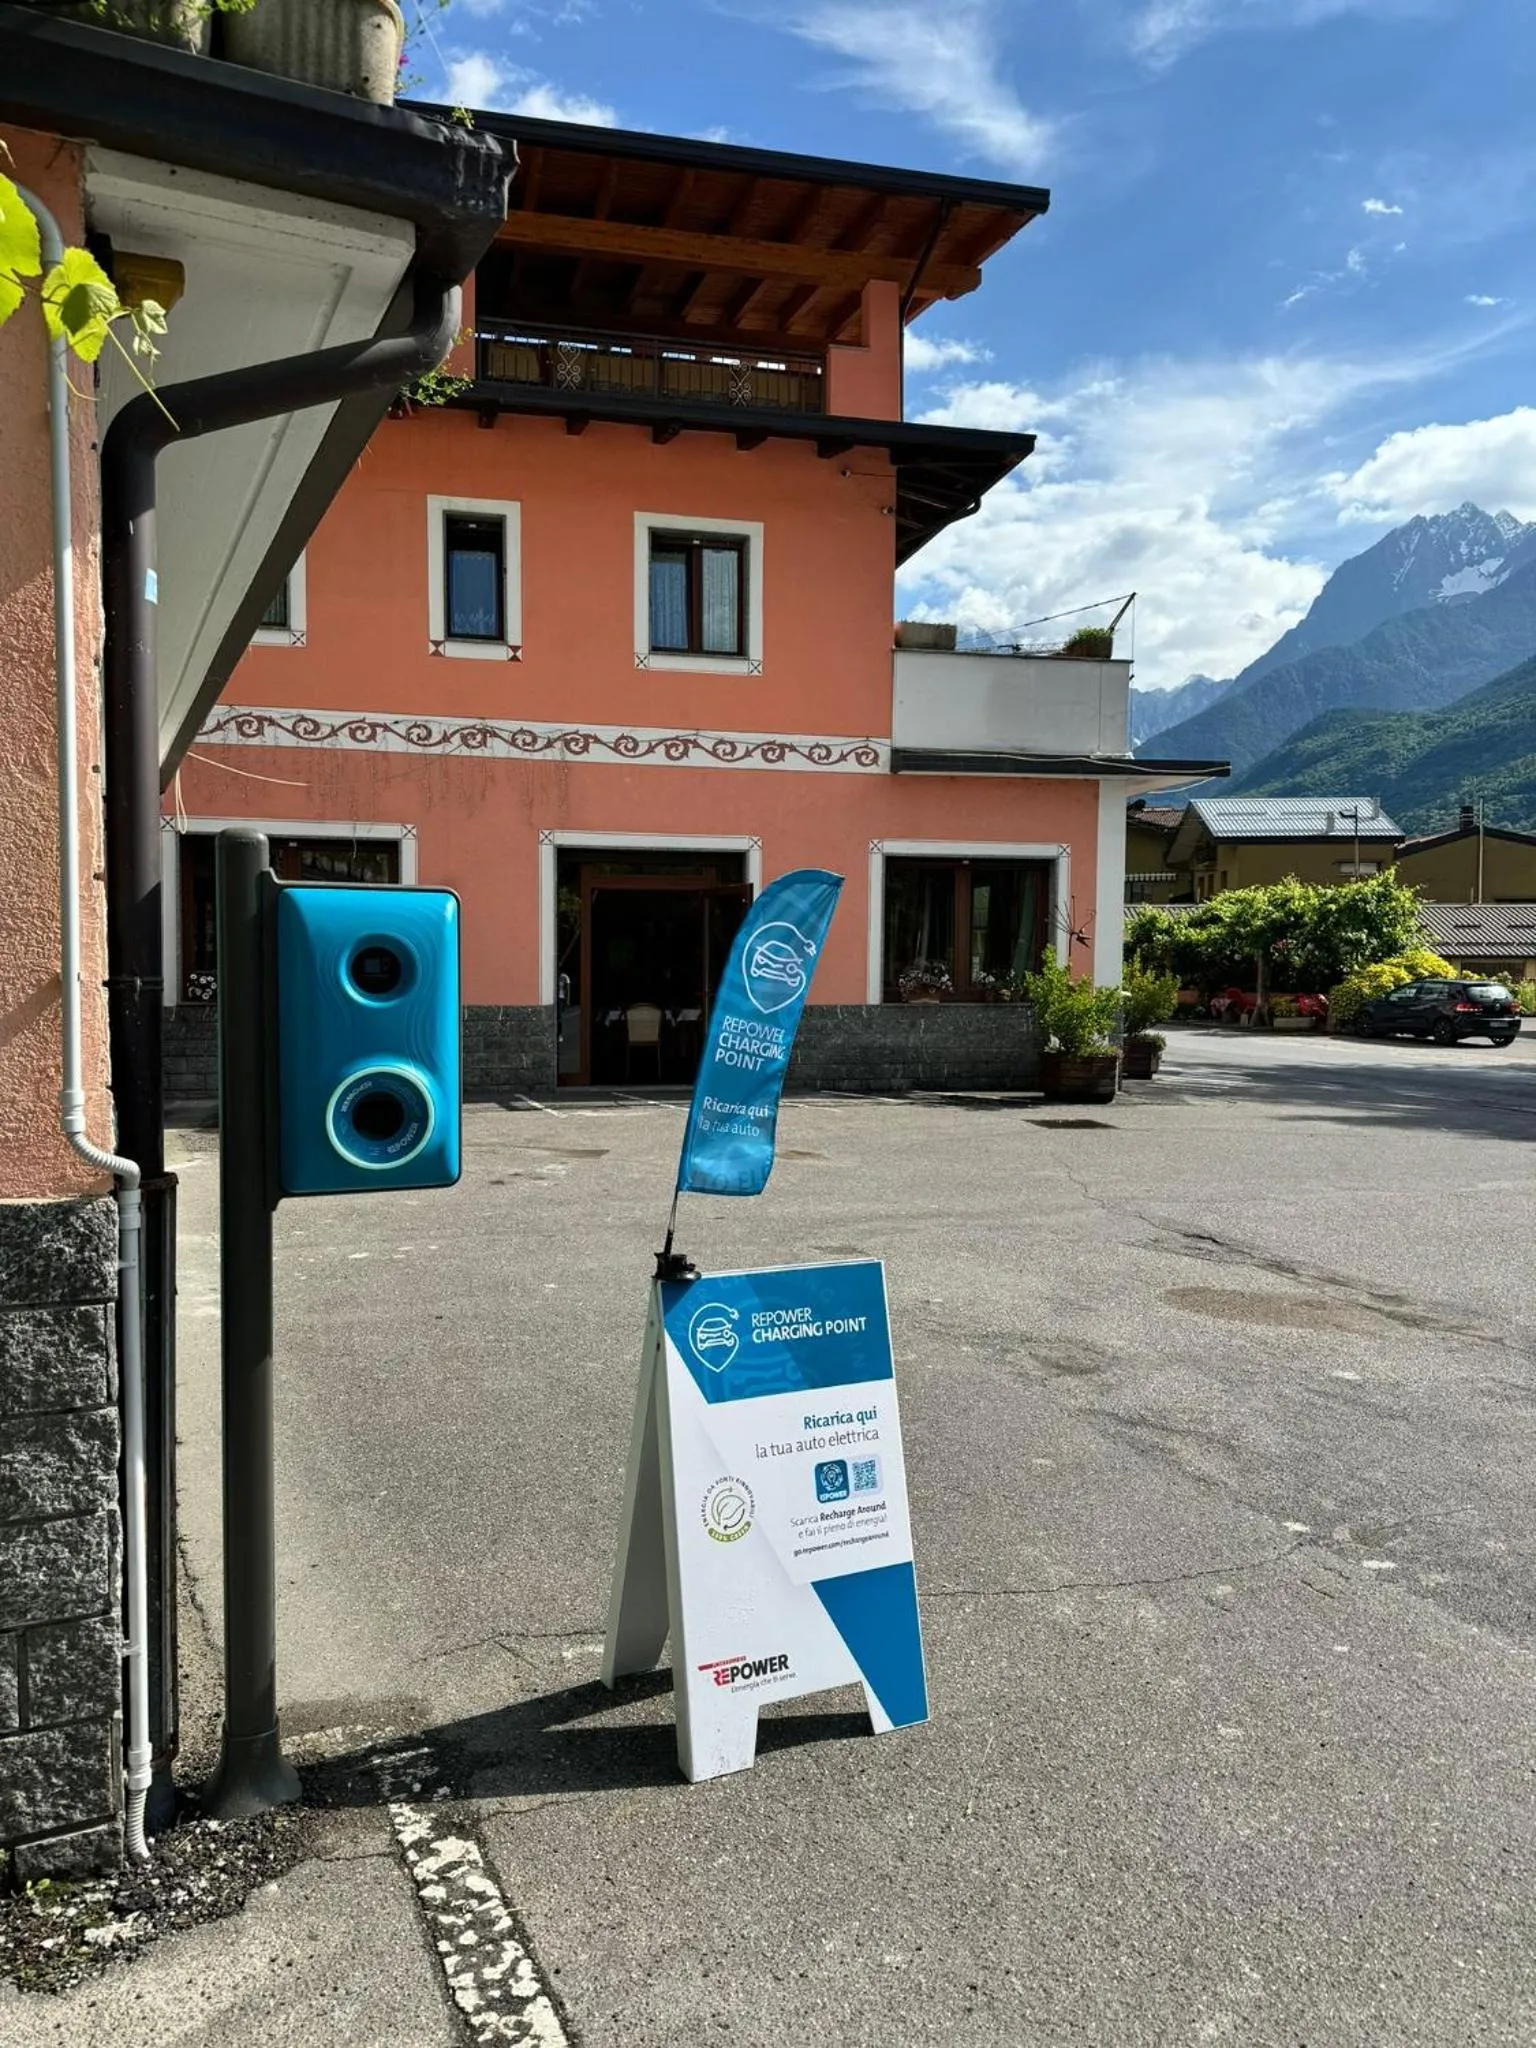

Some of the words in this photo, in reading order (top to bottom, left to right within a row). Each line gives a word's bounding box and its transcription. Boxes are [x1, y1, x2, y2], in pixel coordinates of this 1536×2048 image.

[719, 1032, 786, 1059] CHARGING
[715, 1048, 765, 1072] POINT
[703, 1096, 746, 1115] Ricarica
[748, 1104, 769, 1119] qui
[699, 1116, 710, 1131] la
[713, 1121, 729, 1133] tua
[732, 1124, 760, 1137] auto
[751, 1307, 813, 1328] REPOWER
[752, 1322, 822, 1344] CHARGING
[826, 1316, 867, 1336] POINT
[803, 1412, 854, 1431] Ricarica
[856, 1405, 878, 1426] qui
[755, 1444, 768, 1459] la
[770, 1439, 793, 1456] tua
[796, 1434, 826, 1452] auto
[828, 1428, 880, 1448] elettrica
[790, 1515, 819, 1527] Scarica
[820, 1508, 856, 1521] Recharge
[857, 1501, 887, 1514] Around
[798, 1531, 804, 1539] e
[805, 1527, 815, 1537] fai
[817, 1525, 822, 1535] il
[824, 1523, 846, 1537] pieno
[847, 1519, 855, 1529] di
[713, 1654, 790, 1687] REPOWER
